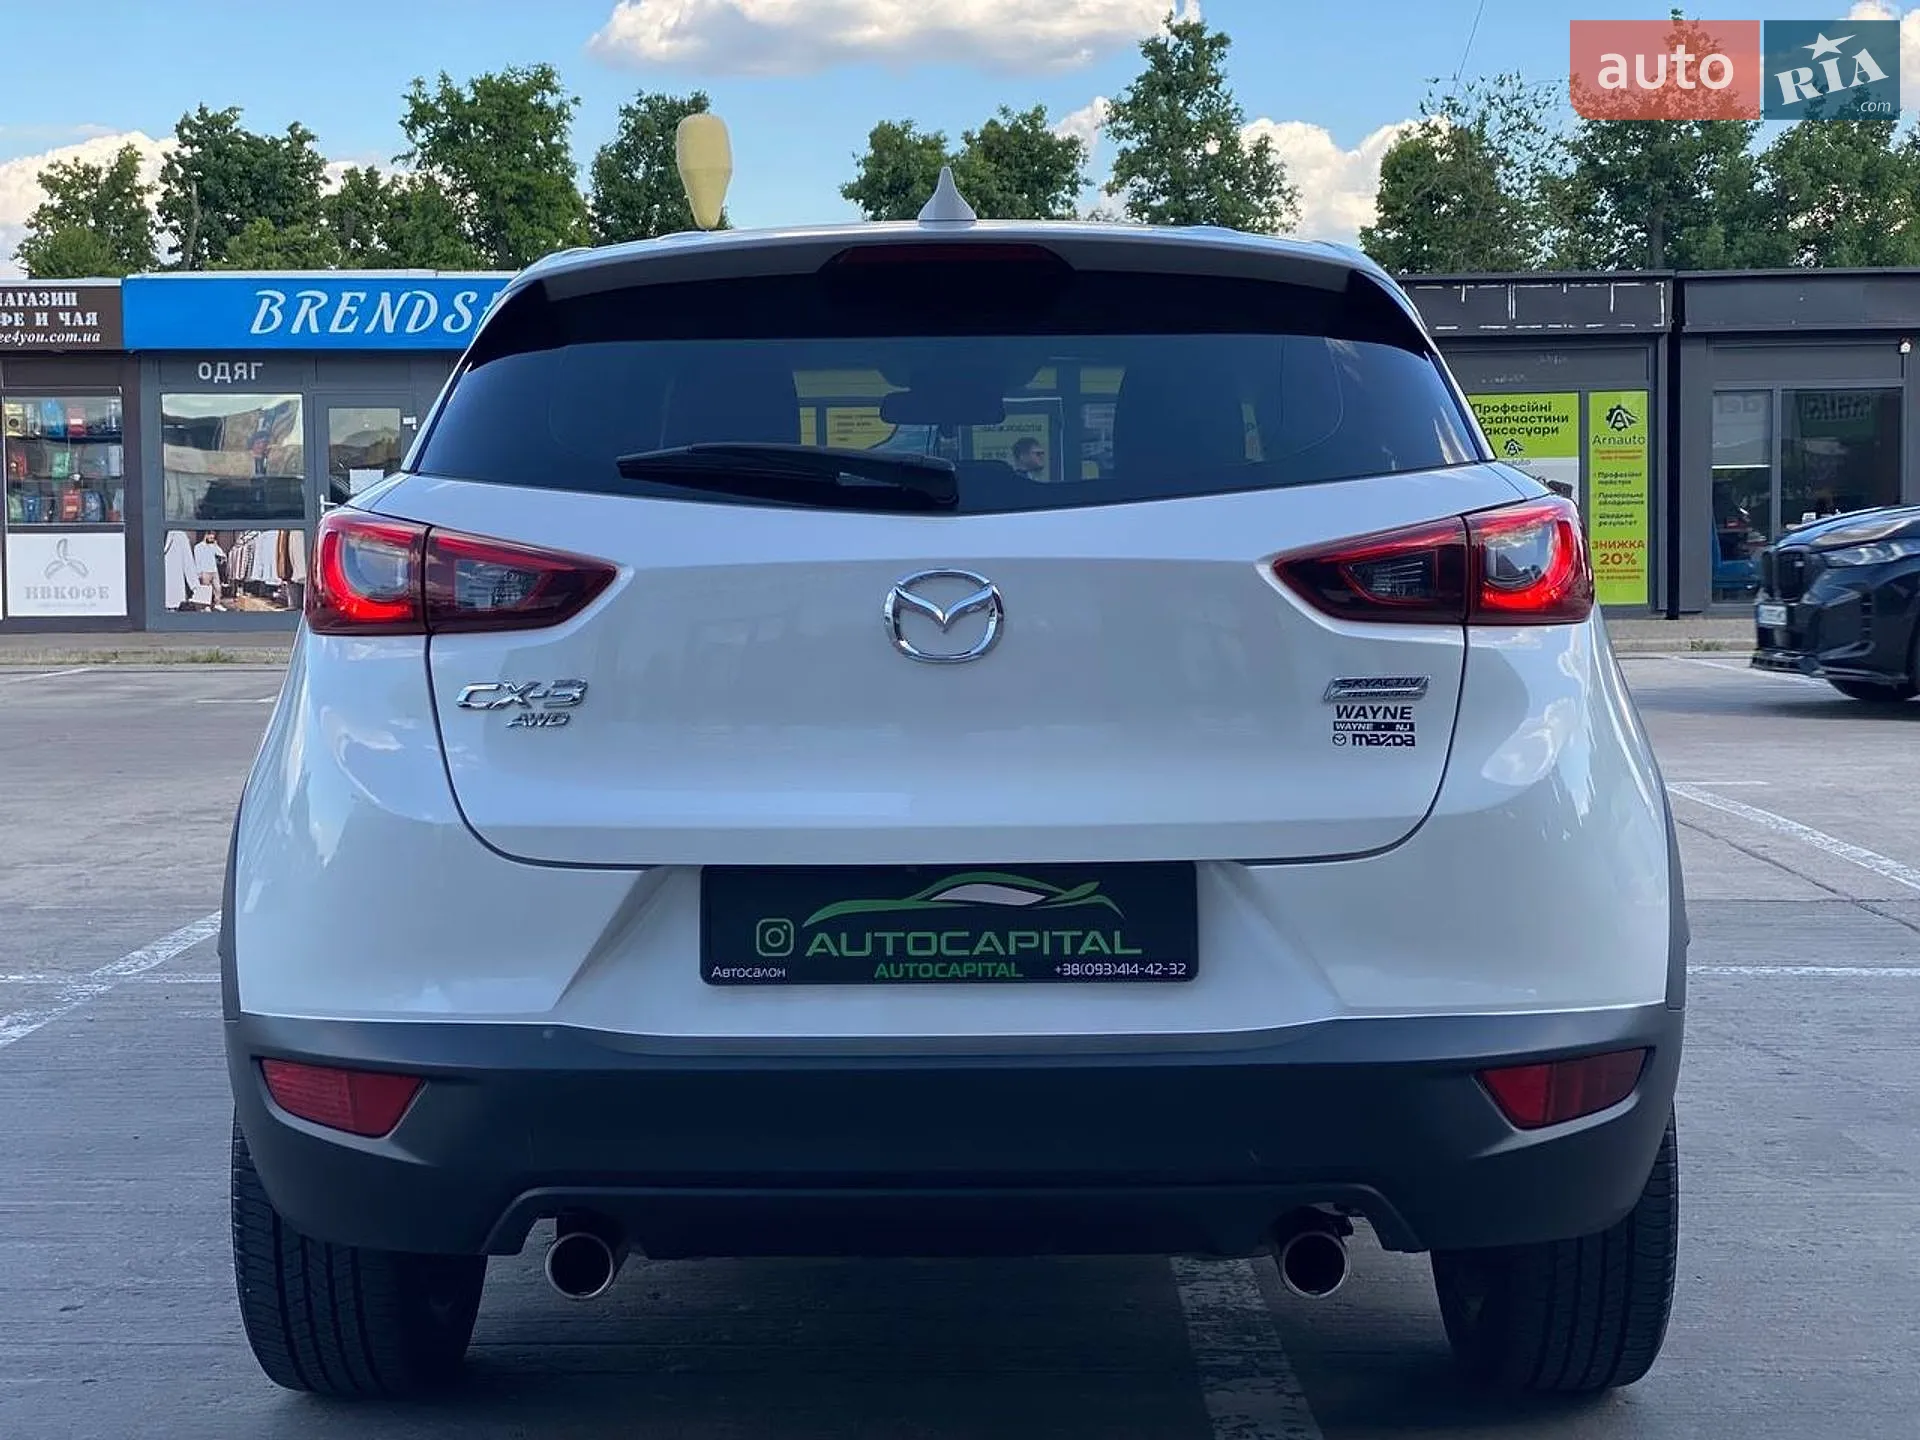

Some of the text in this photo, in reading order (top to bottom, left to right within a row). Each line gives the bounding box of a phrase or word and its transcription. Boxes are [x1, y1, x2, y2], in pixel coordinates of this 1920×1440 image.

[0, 291, 78, 307] АГАЗИН
[35, 311, 48, 326] И
[58, 311, 99, 326] ЧАЯ
[250, 289, 502, 334] BRENDS
[197, 361, 264, 384] ОДЯГ
[1473, 401, 1552, 415] Професійні
[1591, 434, 1646, 446] Arnauto
[1591, 539, 1645, 550] ЗНИЖКА
[1599, 552, 1638, 566] 20%
[456, 679, 589, 710] CX-3
[505, 711, 572, 728] AWD
[1335, 704, 1414, 720] WAYNE
[805, 930, 1143, 957] AUTOCAPITAL
[711, 966, 787, 979] Автосалон
[874, 962, 1025, 979] AUTOCAPITAL
[1054, 962, 1188, 977] +38(093)414-42-32
